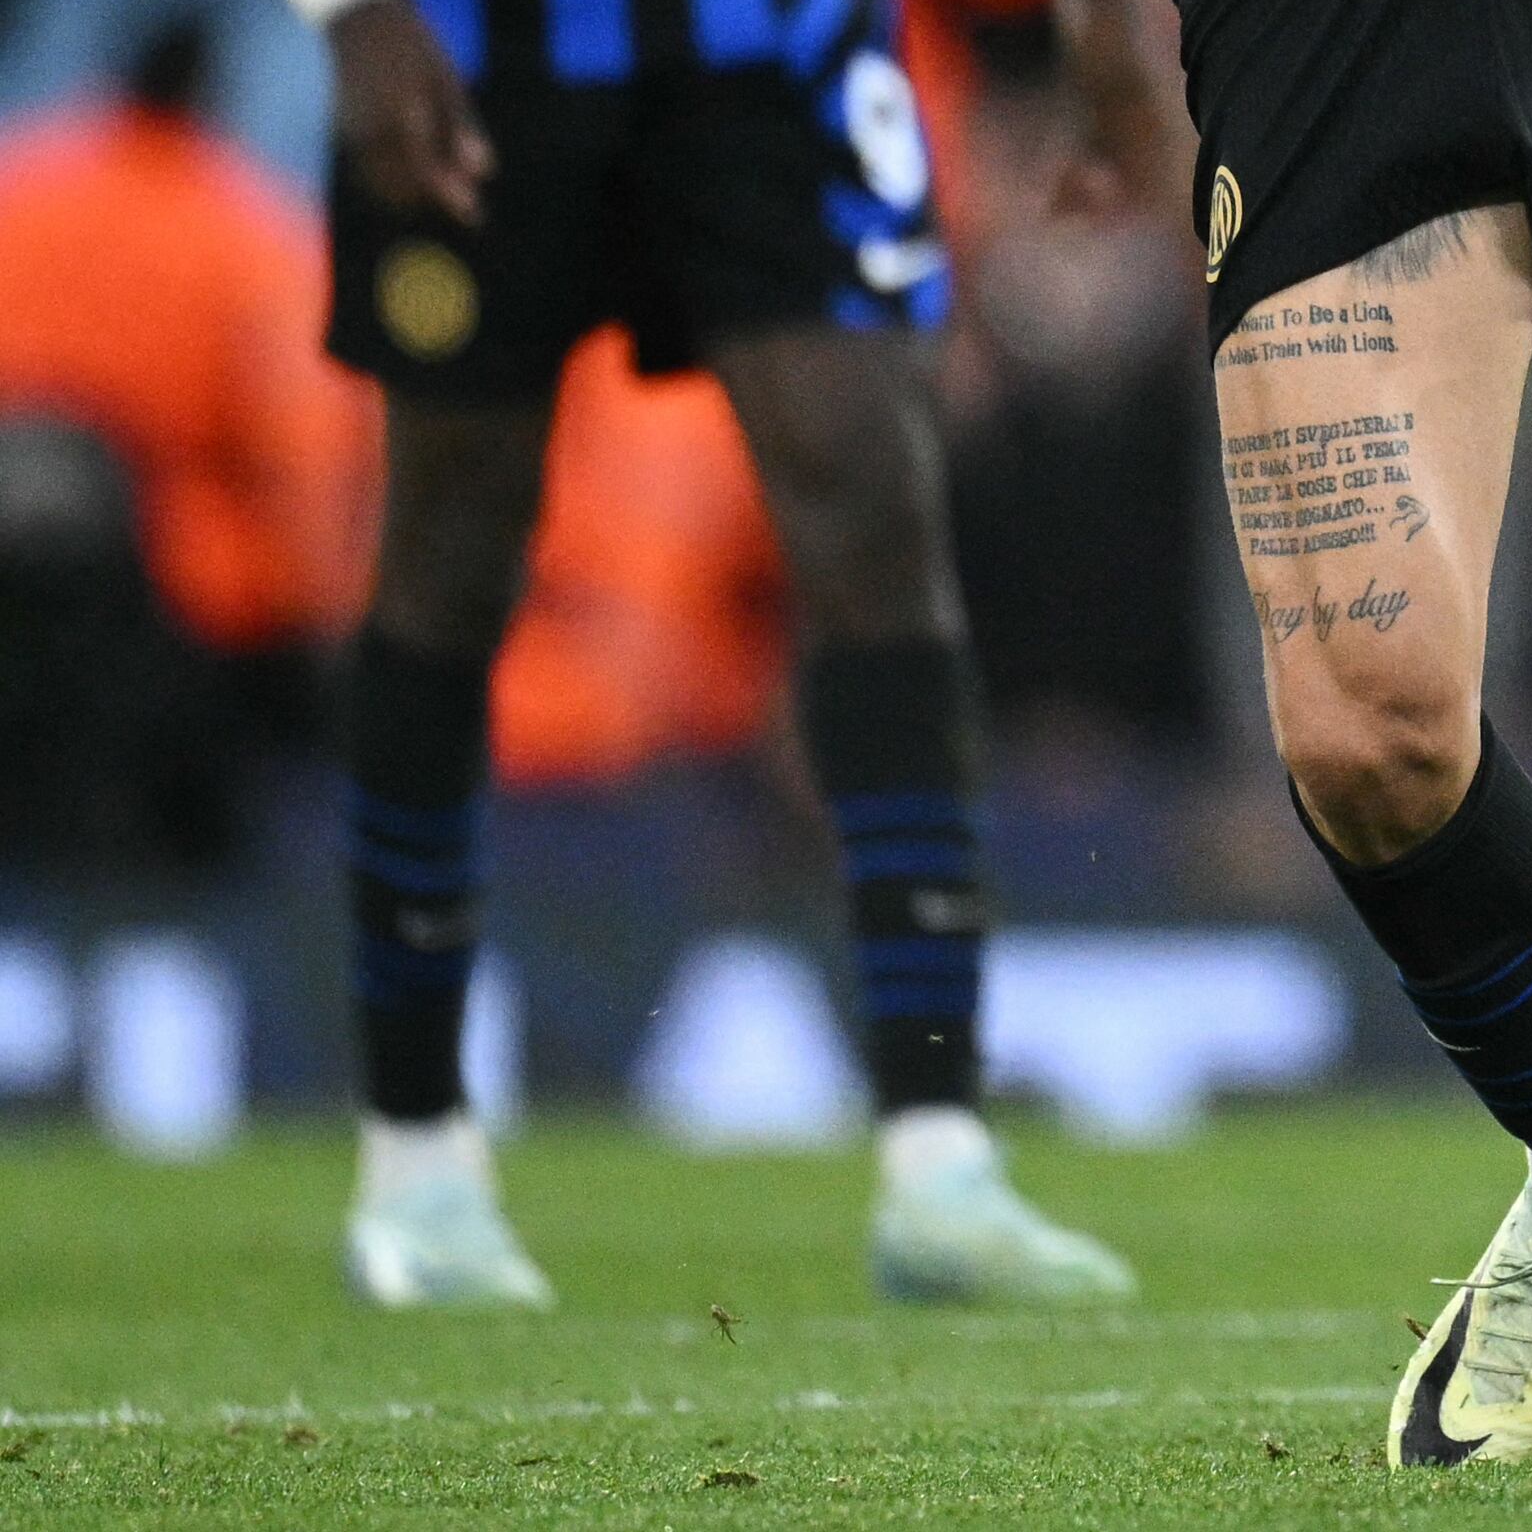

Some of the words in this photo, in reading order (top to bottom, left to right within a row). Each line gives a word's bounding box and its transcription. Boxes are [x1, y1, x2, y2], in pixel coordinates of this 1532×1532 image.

[1281, 308, 1302, 327] To
[1309, 304, 1334, 325] Be
[1339, 307, 1349, 324] a
[1261, 337, 1302, 362] Train
[1336, 446, 1356, 465] IL
[1297, 475, 1337, 499] COSE
[1342, 468, 1378, 491] CHE
[1312, 585, 1338, 643] by
[1348, 577, 1410, 633] day
